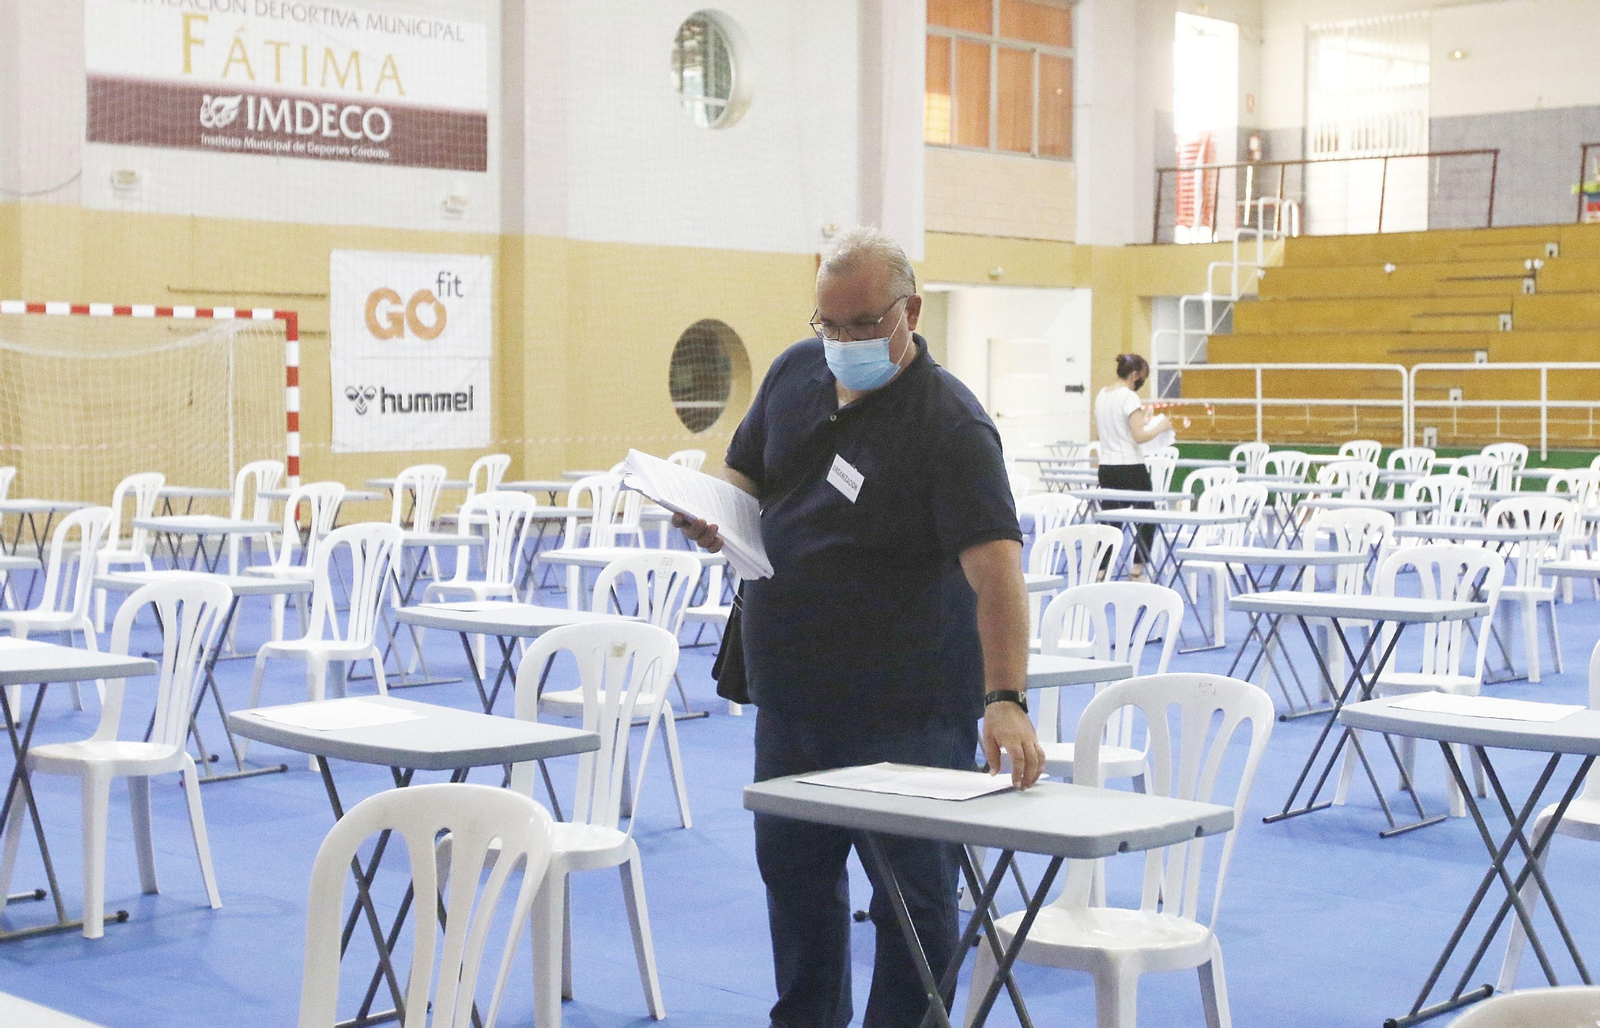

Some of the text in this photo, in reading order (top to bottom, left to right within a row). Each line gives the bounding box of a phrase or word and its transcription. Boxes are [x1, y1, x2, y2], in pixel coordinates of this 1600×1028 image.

[255, 1, 360, 30] DEPORTIVA
[366, 13, 465, 42] MUNICIPAL
[181, 12, 406, 96] FÁTIMA
[246, 95, 392, 142] IMDECO
[201, 134, 242, 148] Instituto
[243, 136, 290, 152] Municipal
[292, 140, 305, 151] de
[307, 141, 352, 156] Deportes
[364, 271, 464, 340] GO fit
[380, 385, 474, 414] hummel
